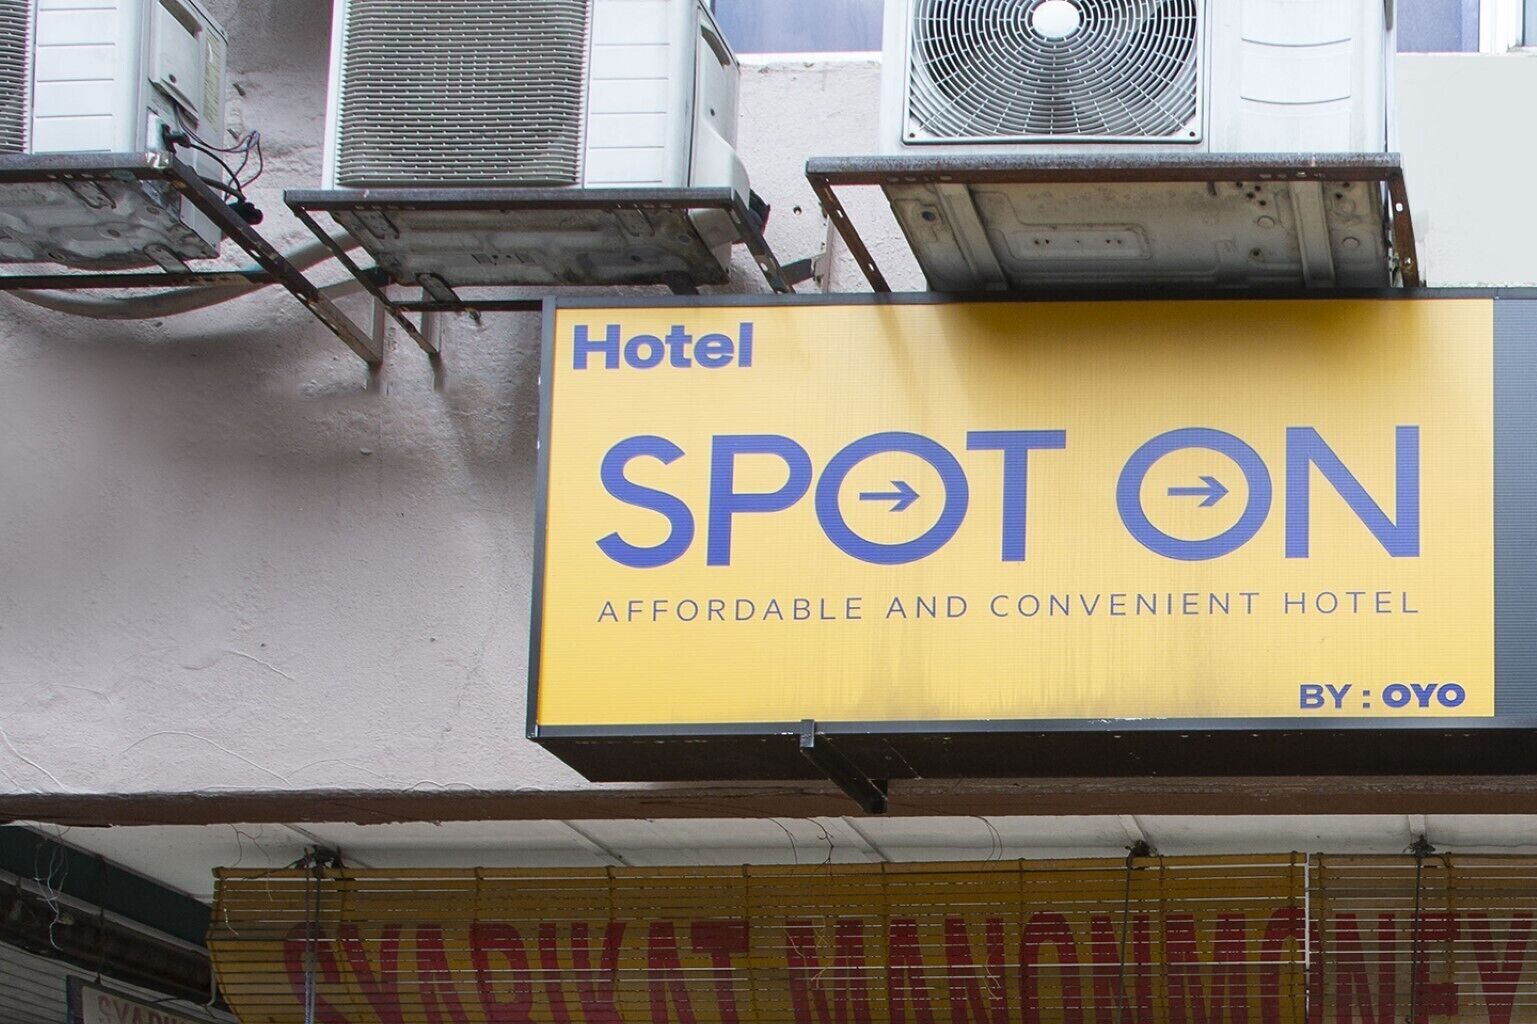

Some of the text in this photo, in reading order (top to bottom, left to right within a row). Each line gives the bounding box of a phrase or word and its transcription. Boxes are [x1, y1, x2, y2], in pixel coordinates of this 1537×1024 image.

[573, 322, 753, 370] Hotel
[595, 425, 1421, 569] SPOT ON
[597, 590, 1420, 624] AFFORDABLE AND CONVENIENT HOTEL
[1299, 683, 1352, 710] BY
[1381, 682, 1466, 709] OYO
